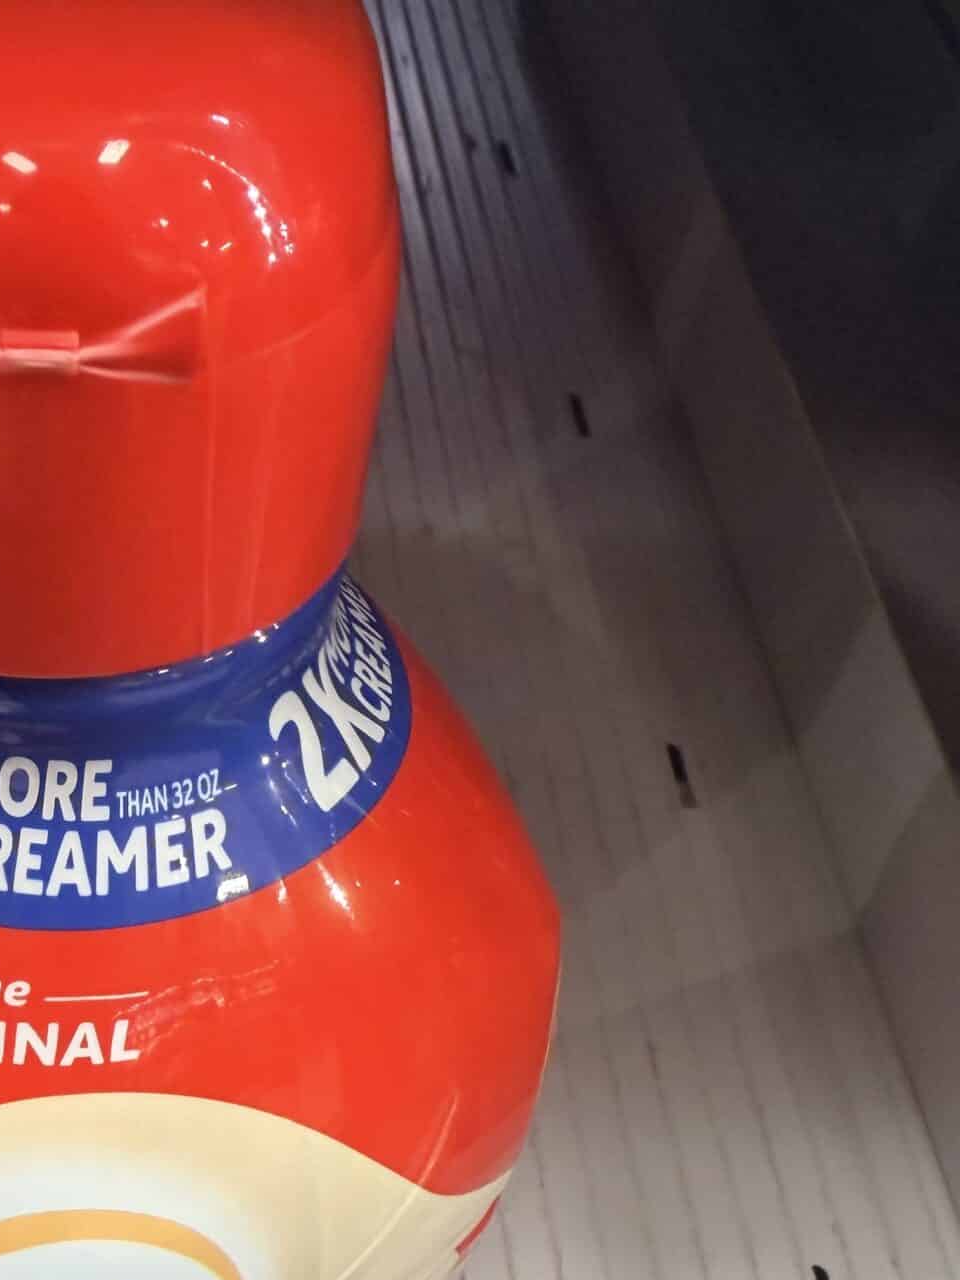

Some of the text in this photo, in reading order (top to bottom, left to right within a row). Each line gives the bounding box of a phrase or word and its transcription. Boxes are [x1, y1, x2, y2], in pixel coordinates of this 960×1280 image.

[269, 645, 386, 812] 2X
[116, 784, 169, 818] THAN
[172, 781, 195, 810] 32
[197, 769, 224, 801] OZ
